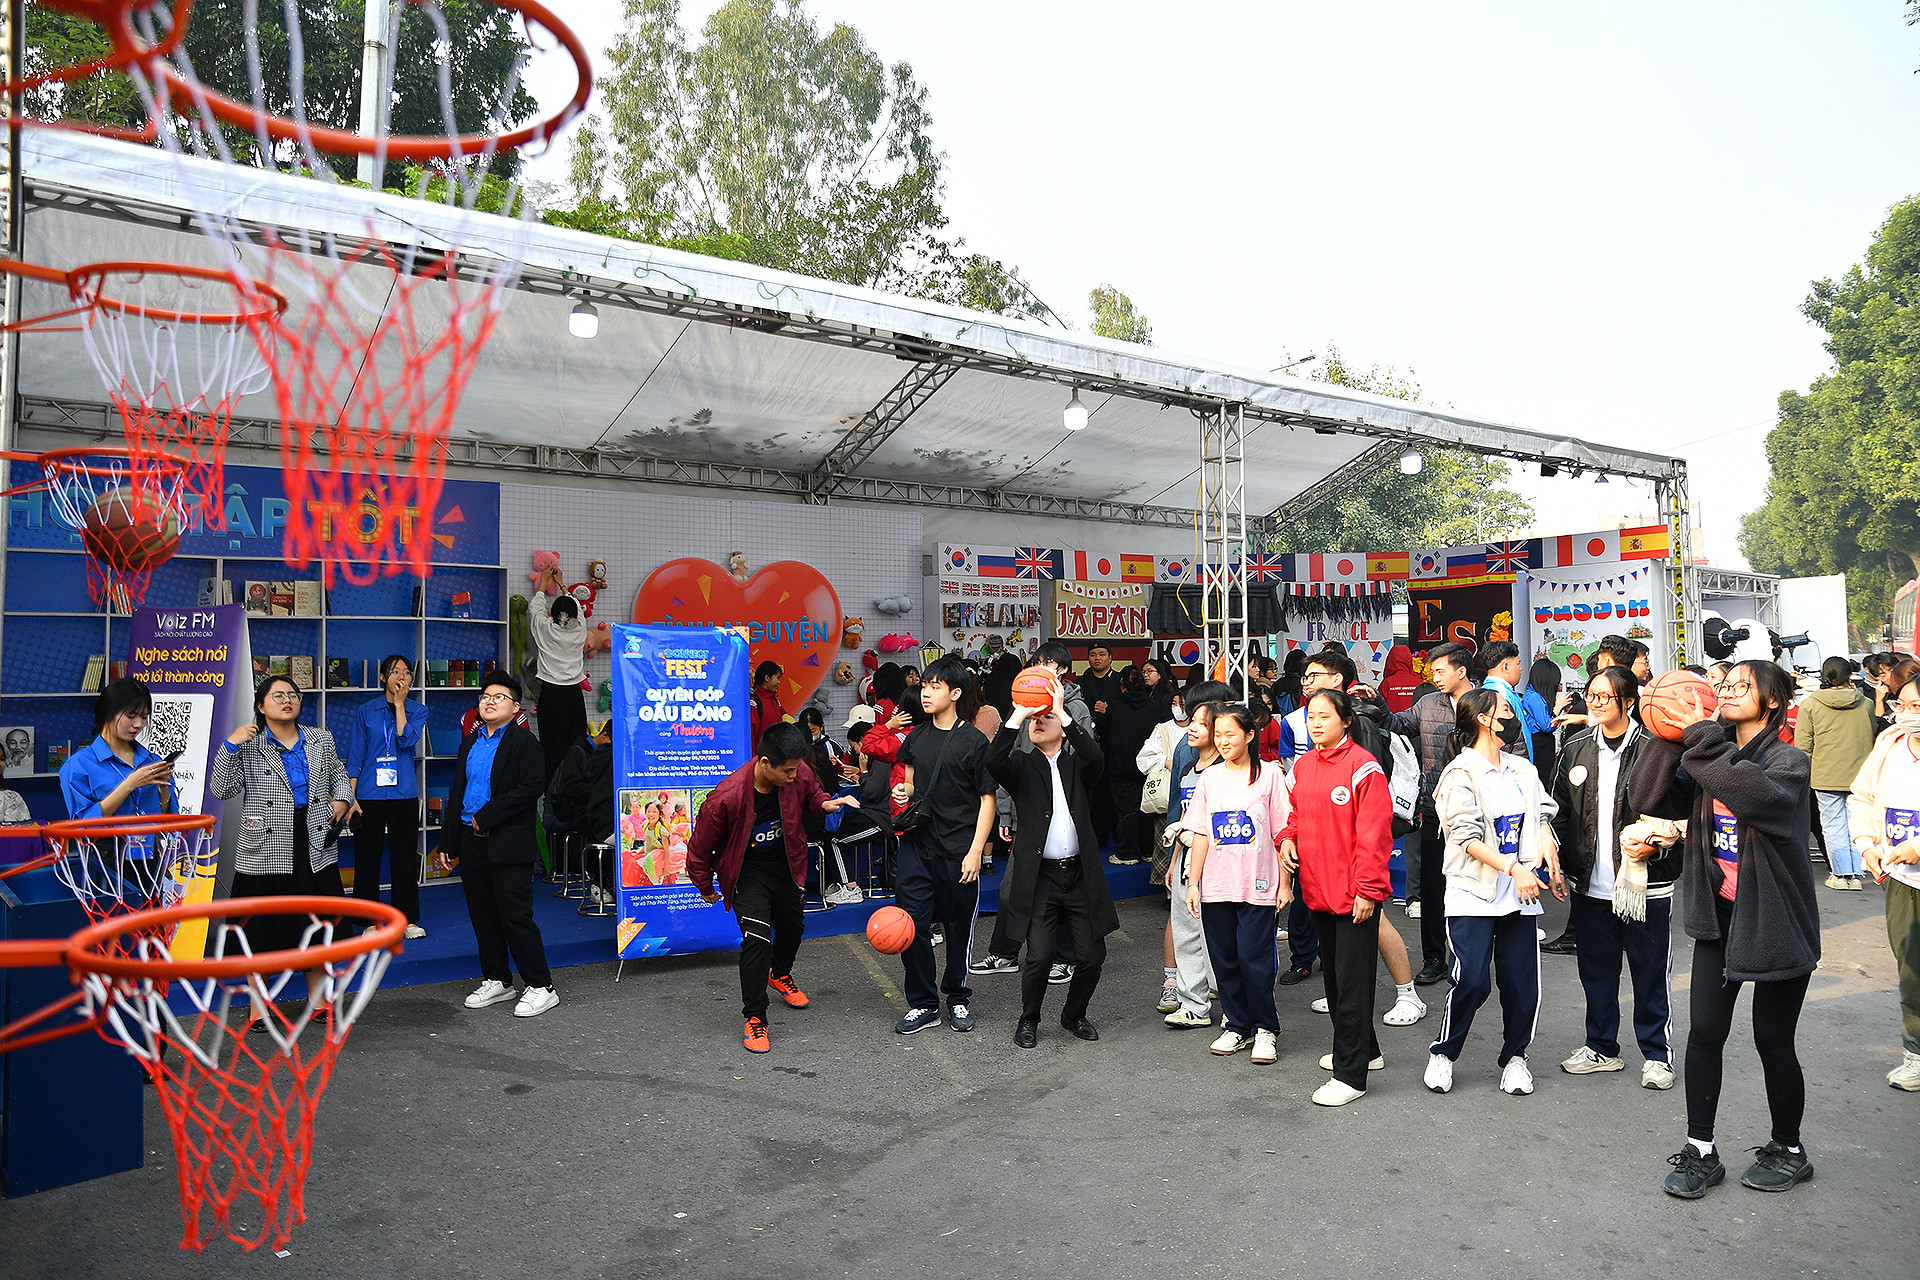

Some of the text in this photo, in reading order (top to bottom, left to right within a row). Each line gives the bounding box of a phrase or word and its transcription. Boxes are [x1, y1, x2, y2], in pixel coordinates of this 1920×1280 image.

[181, 483, 294, 550] TẬP
[307, 483, 422, 545] TỐT
[192, 612, 216, 629] FM
[943, 602, 1042, 628] ENGLAND
[1057, 602, 1147, 637] JAPAN
[1308, 621, 1369, 641] FRANCE
[135, 644, 228, 667] Nghe sách nói
[663, 648, 710, 659] CONNECT
[666, 659, 704, 677] FEST
[164, 669, 195, 683] thành
[195, 669, 226, 687] công
[645, 686, 725, 702] QUYÊN GÓP
[638, 701, 733, 722] GẤU BÔNG
[1217, 823, 1253, 839] 1696
